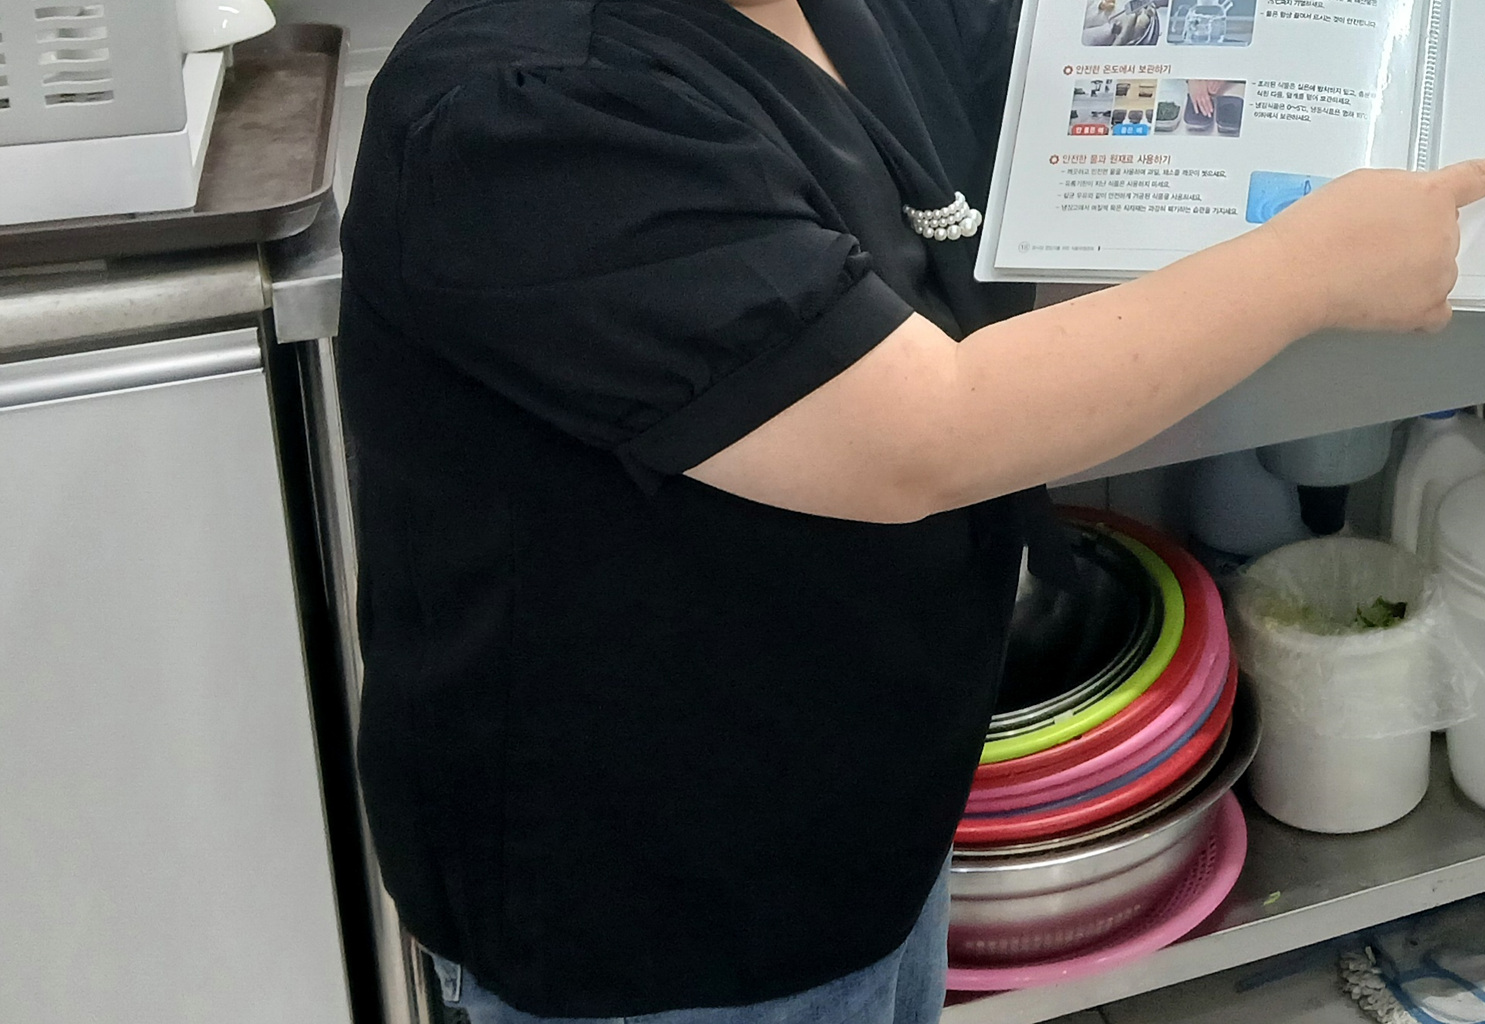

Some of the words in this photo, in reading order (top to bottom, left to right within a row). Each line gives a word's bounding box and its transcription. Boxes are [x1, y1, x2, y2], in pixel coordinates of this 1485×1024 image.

[1075, 64, 1100, 75] 안전한
[1102, 64, 1136, 74] 온도에서
[1138, 64, 1172, 74] 보관하기
[1062, 155, 1087, 164] 안전한
[1109, 154, 1134, 164] 원재료
[1136, 154, 1172, 165] 사용하기
